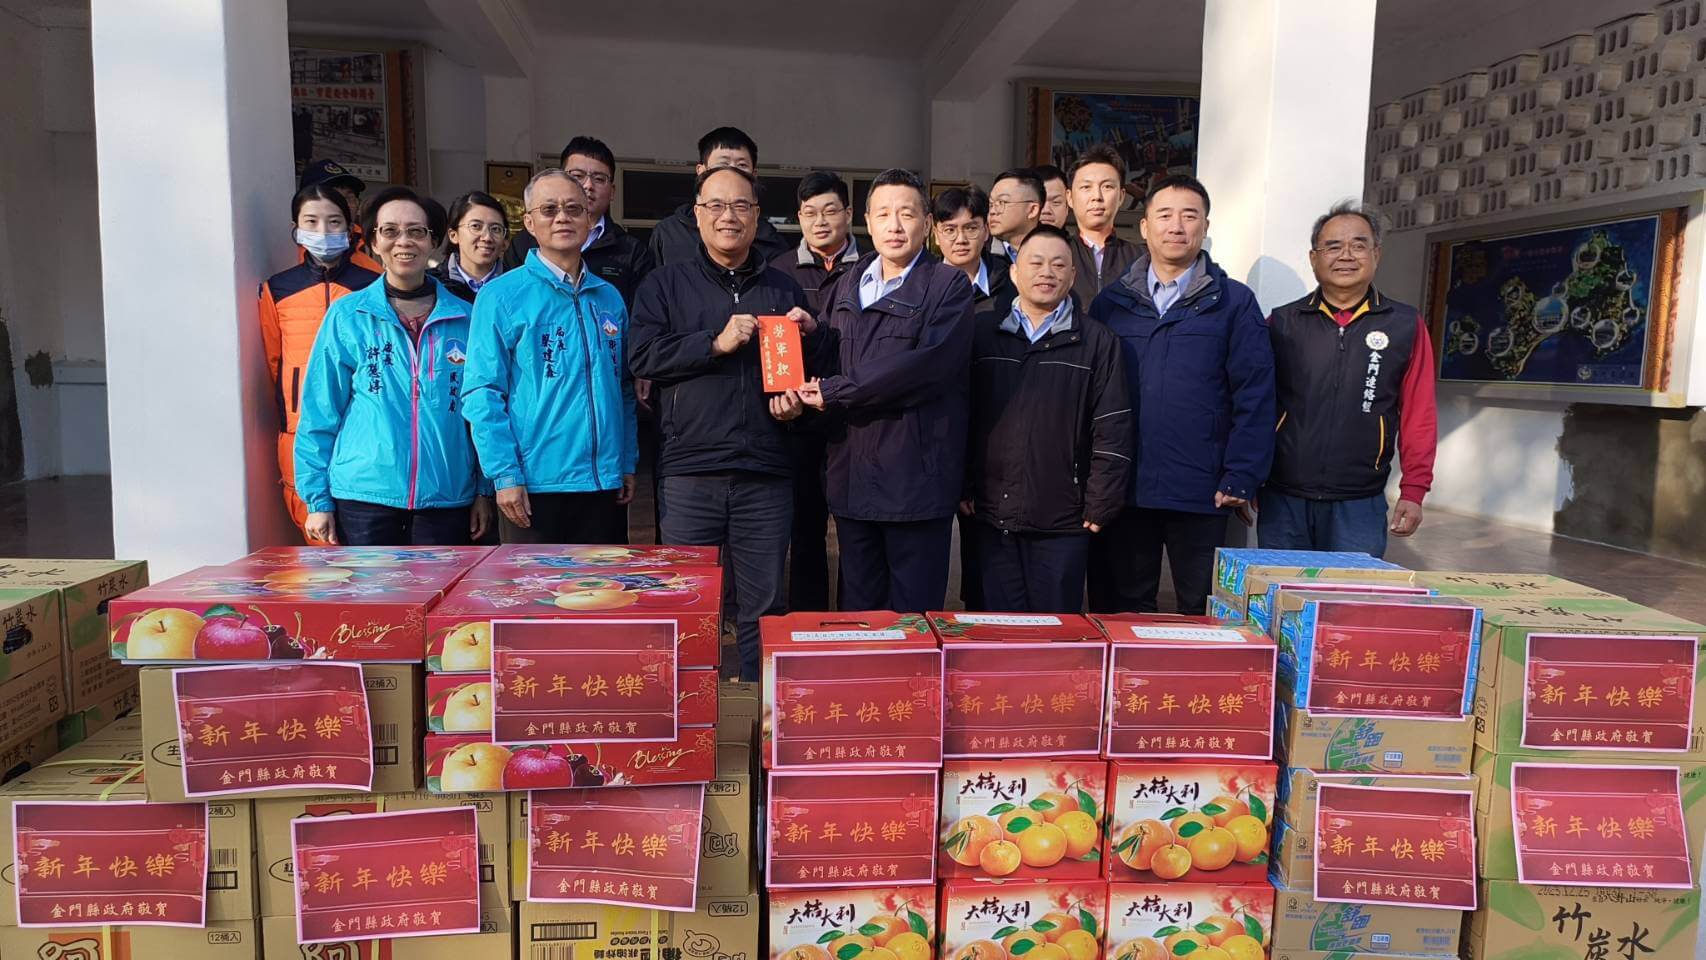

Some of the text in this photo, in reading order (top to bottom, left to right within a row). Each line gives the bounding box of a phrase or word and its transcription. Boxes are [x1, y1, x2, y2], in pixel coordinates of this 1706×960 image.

[330, 623, 404, 644] Blessing
[1325, 648, 1441, 673] 新年快樂
[509, 673, 646, 699] 新年快樂
[1539, 683, 1664, 708] 新年快樂
[958, 692, 1076, 716] 新年快樂
[1124, 692, 1243, 715] 新年快樂
[1333, 691, 1432, 708] 金門縣政府敬賀
[790, 700, 914, 725] 新年快樂
[198, 715, 341, 746] 新年快樂
[524, 721, 638, 736] 金門縣政府敬賀
[1551, 728, 1654, 744] 金門縣政府敬賀
[803, 744, 907, 761] 金門縣政府敬賀
[968, 734, 1067, 750] 金門縣政府敬賀
[1135, 736, 1237, 751] 金門縣政府敬賀
[627, 748, 696, 769] Blessing
[219, 763, 337, 785] 金門縣政府敬賀
[209, 806, 233, 816] 2桶入
[784, 820, 907, 843] 新年快樂
[1531, 815, 1657, 840] 新年快樂
[544, 829, 668, 859] 新年快樂
[1330, 835, 1446, 862] 新年快樂
[33, 854, 176, 880] 新年快樂
[314, 861, 448, 894] 新年快樂
[797, 864, 899, 879] 金門縣政府敬賀
[1550, 862, 1655, 879] 金門縣政府敬賀
[557, 877, 659, 900] 金門縣政府敬賀
[1342, 879, 1441, 900] 金門縣政府敬賀
[50, 901, 168, 919] 金門縣政府敬賀
[331, 910, 442, 933] 金門縣政府敬賀
[210, 932, 239, 942] 12桶入
[1553, 902, 1656, 960] 竹炭水
